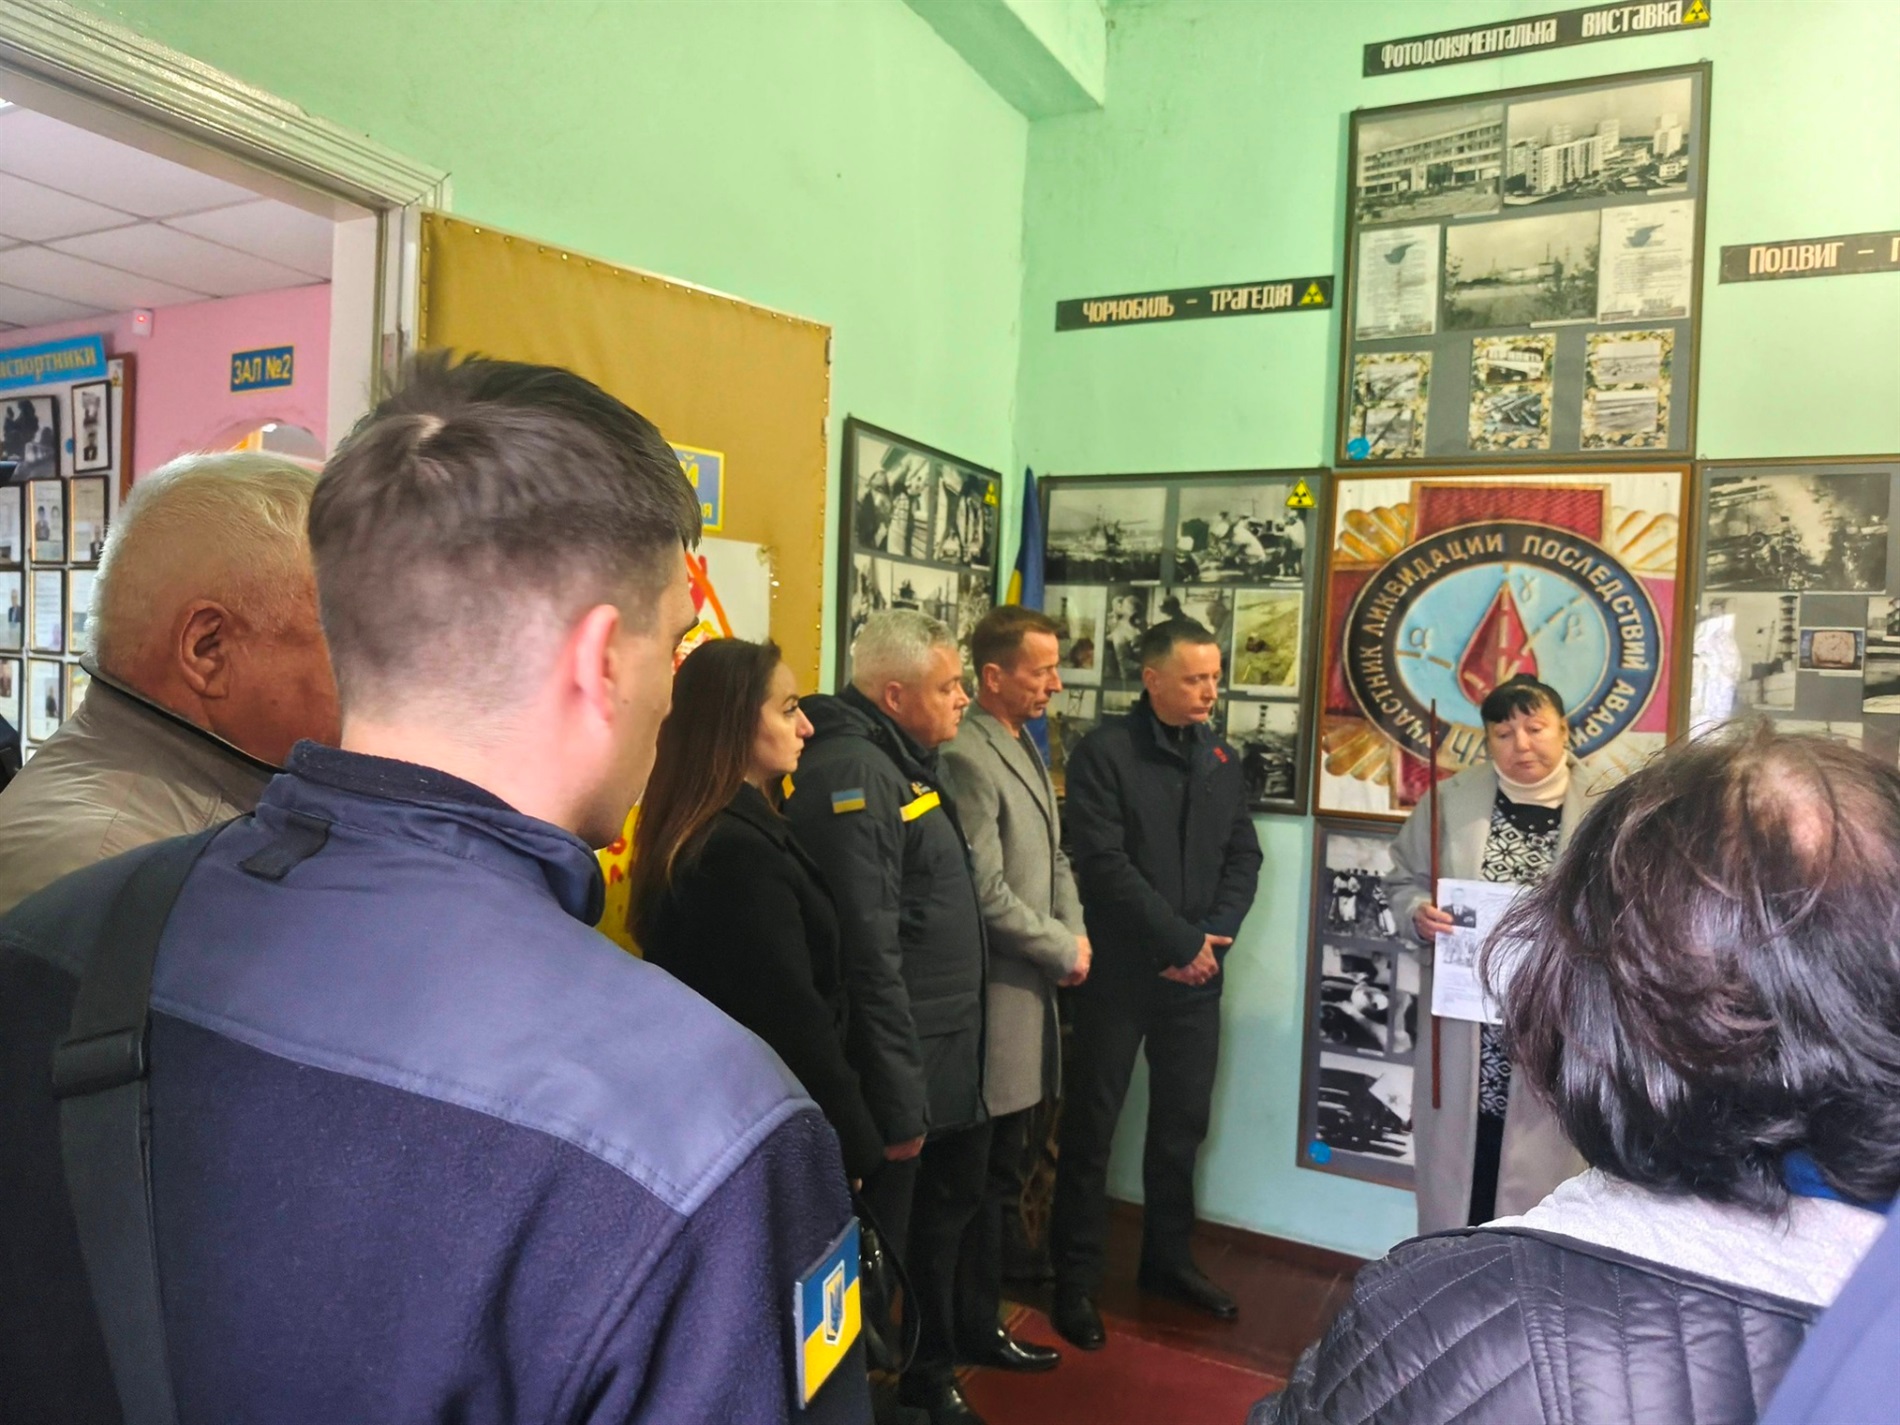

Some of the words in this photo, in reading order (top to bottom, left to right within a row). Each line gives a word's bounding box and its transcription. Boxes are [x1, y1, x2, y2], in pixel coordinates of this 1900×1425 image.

[1381, 18, 1557, 69] ФОТОДОКУМЕНТАЛЬНА
[1581, 0, 1683, 38] ВИСТАВКА
[1749, 241, 1845, 275] ПОДВИГ
[1082, 295, 1175, 323] ЧОРНОБИЛЬ
[1209, 283, 1294, 312] ТРАГЕДІЯ
[233, 357, 262, 385] ЗАЛ
[264, 353, 292, 380] №2
[1369, 532, 1505, 639] ЛИКВИДАЦИИ
[1522, 533, 1650, 672] ПОСЛЕДСТВИЙ
[1568, 677, 1636, 750] АВАРИ
